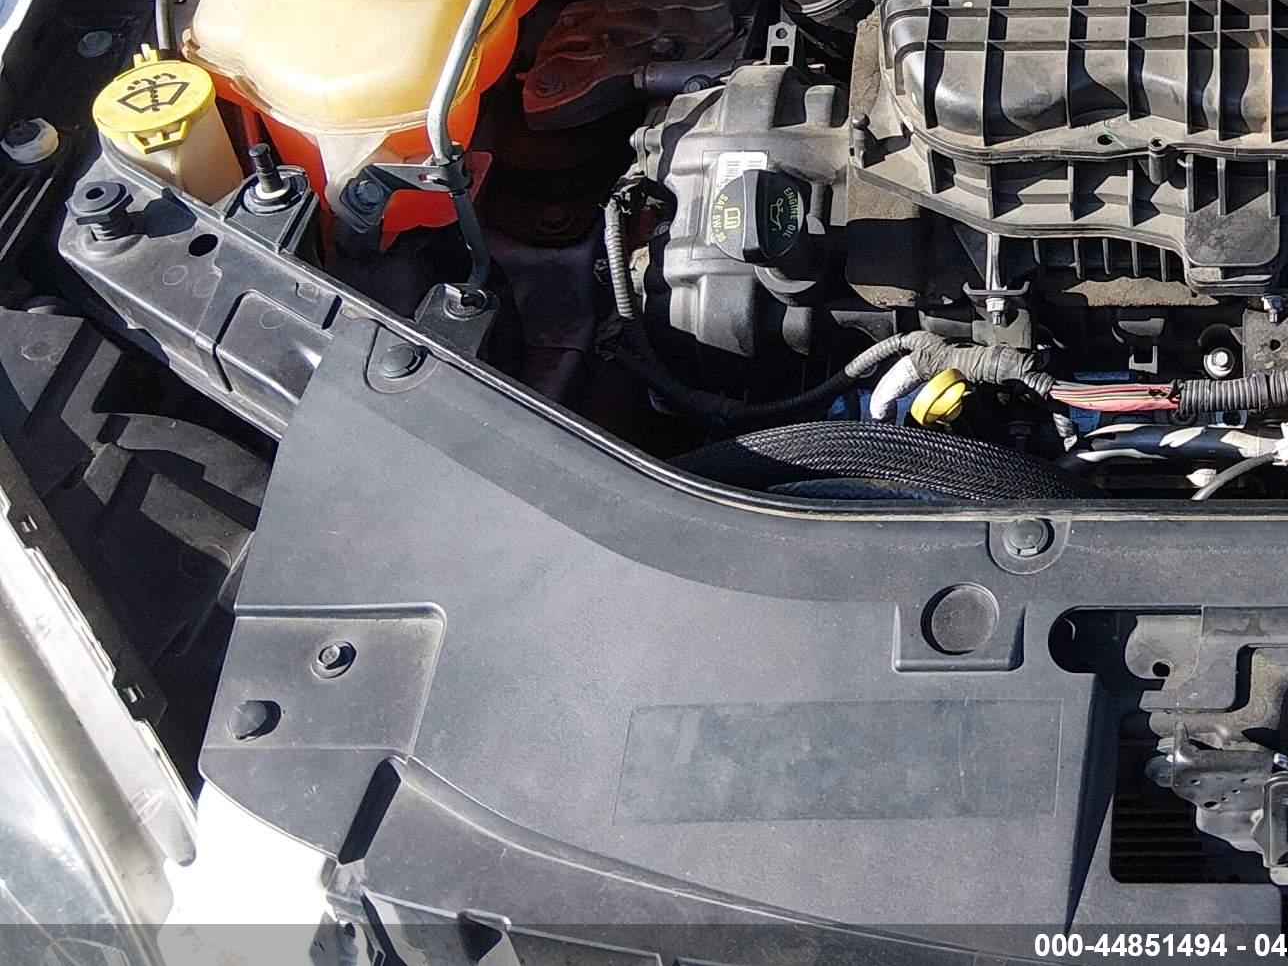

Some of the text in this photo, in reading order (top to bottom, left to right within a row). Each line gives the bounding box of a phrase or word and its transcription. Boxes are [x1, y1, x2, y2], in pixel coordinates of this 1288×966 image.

[714, 194, 729, 212] SAE
[782, 187, 800, 239] ENGINE OIL
